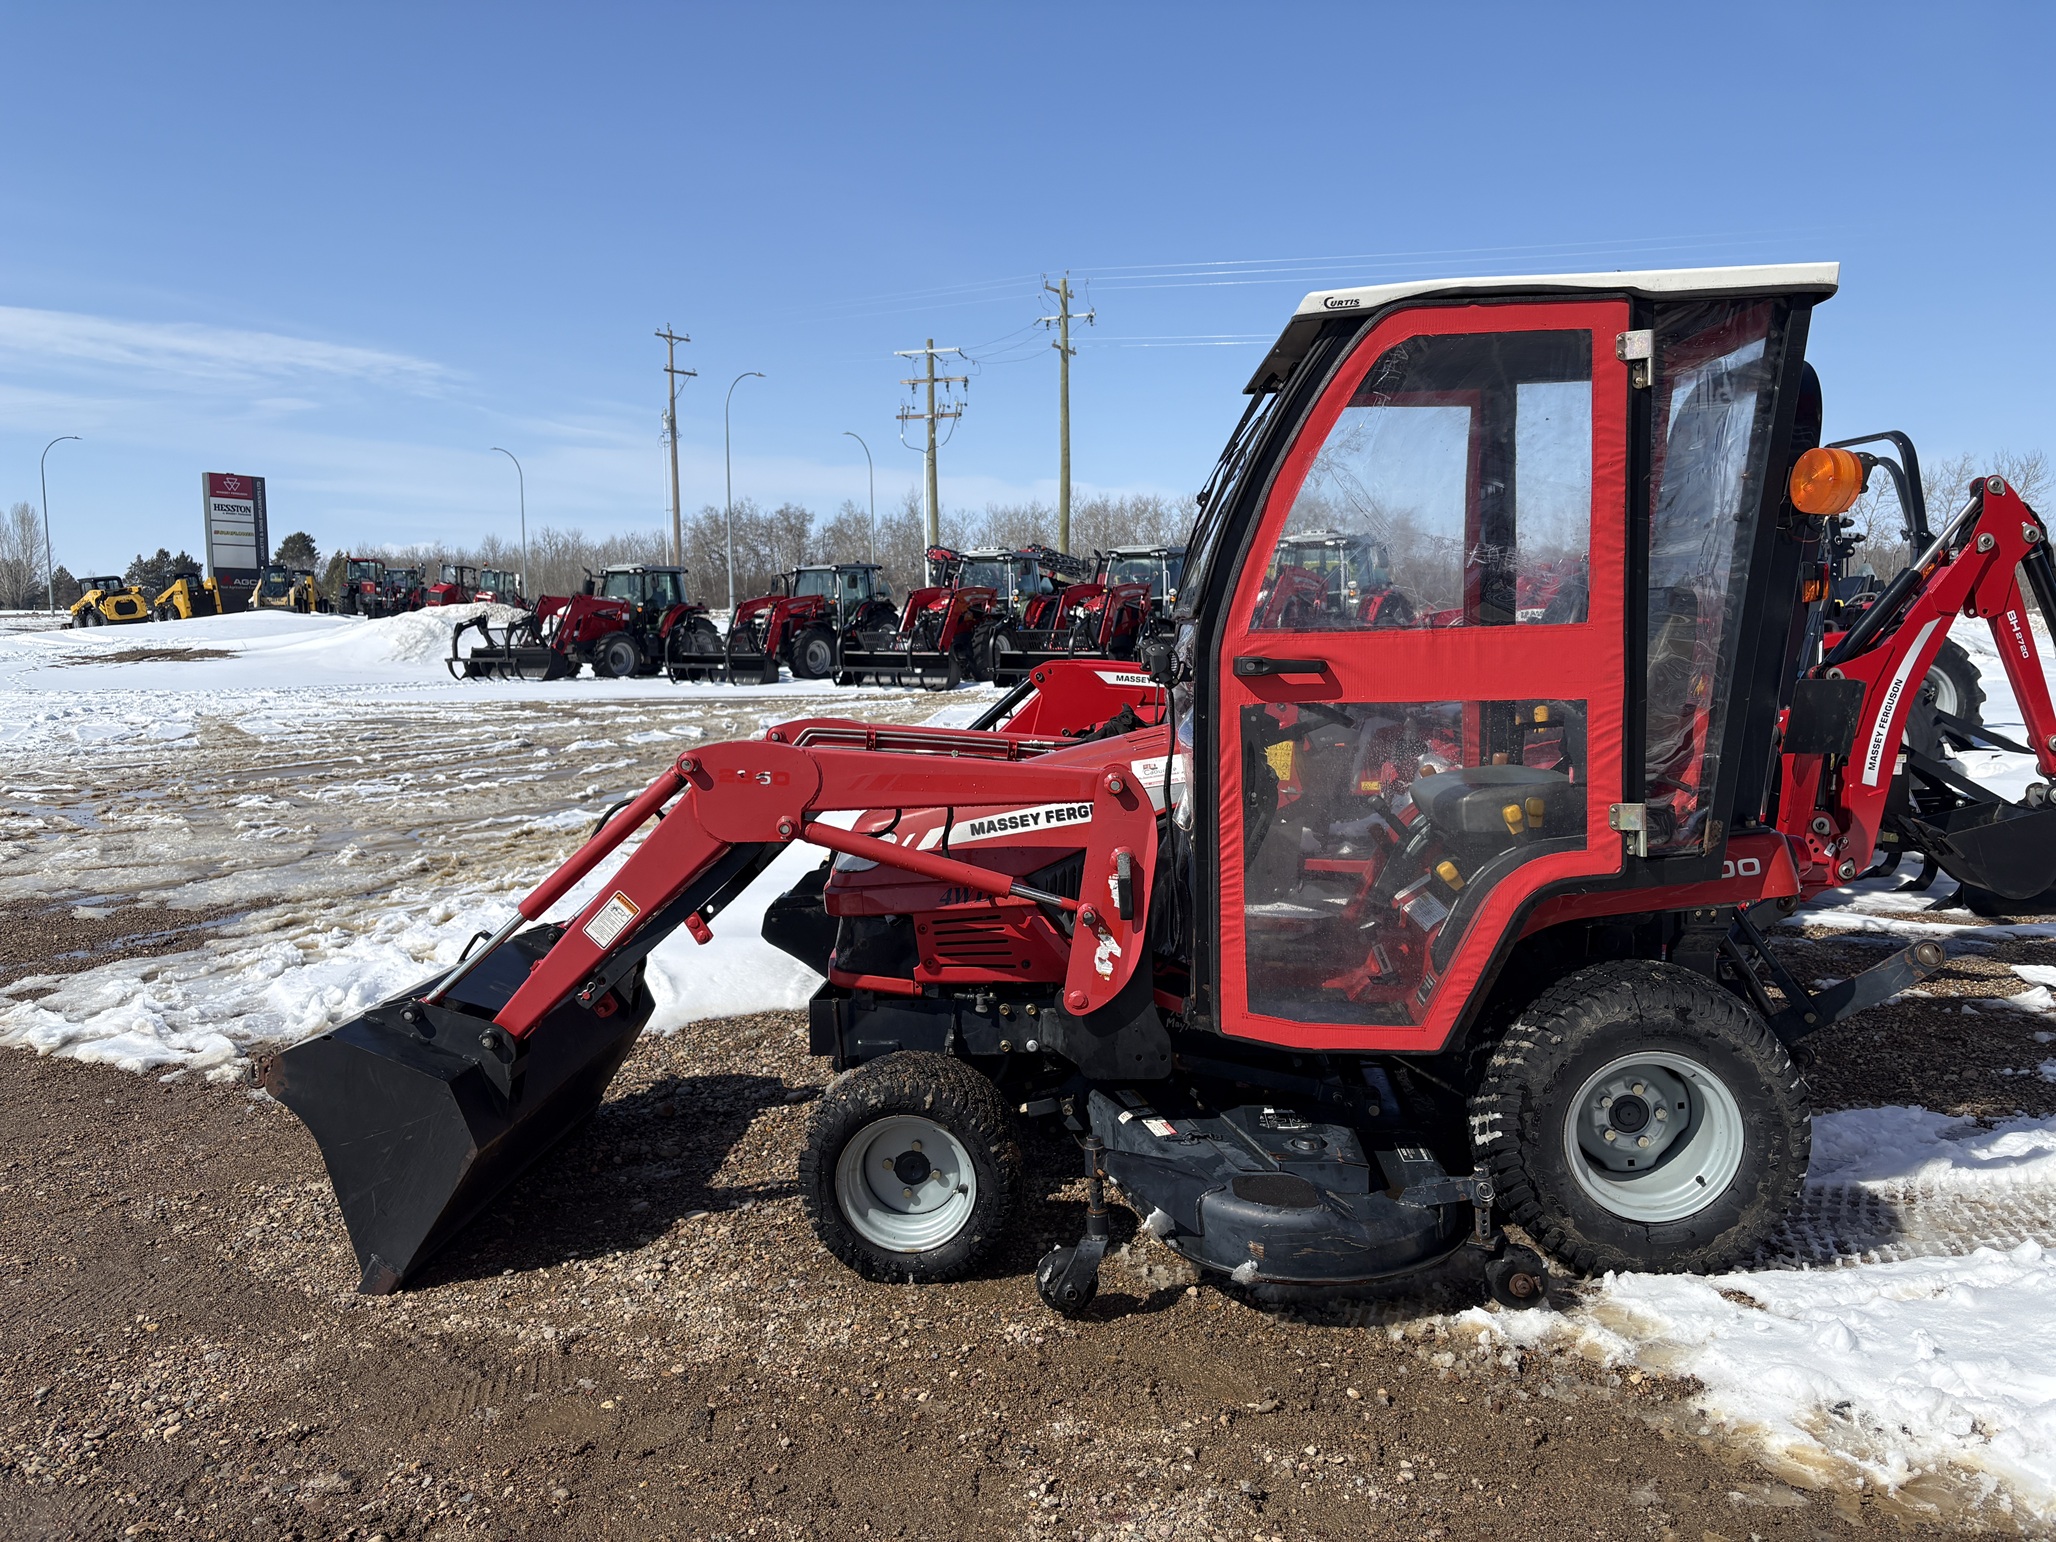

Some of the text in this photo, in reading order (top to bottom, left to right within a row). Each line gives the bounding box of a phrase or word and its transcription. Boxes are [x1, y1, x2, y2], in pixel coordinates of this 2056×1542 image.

[1324, 297, 1360, 309] CURTIS
[213, 503, 252, 513] HESSTON
[1868, 678, 1903, 771] MASSEY FERGUSON
[970, 812, 1040, 836] MASSEY
